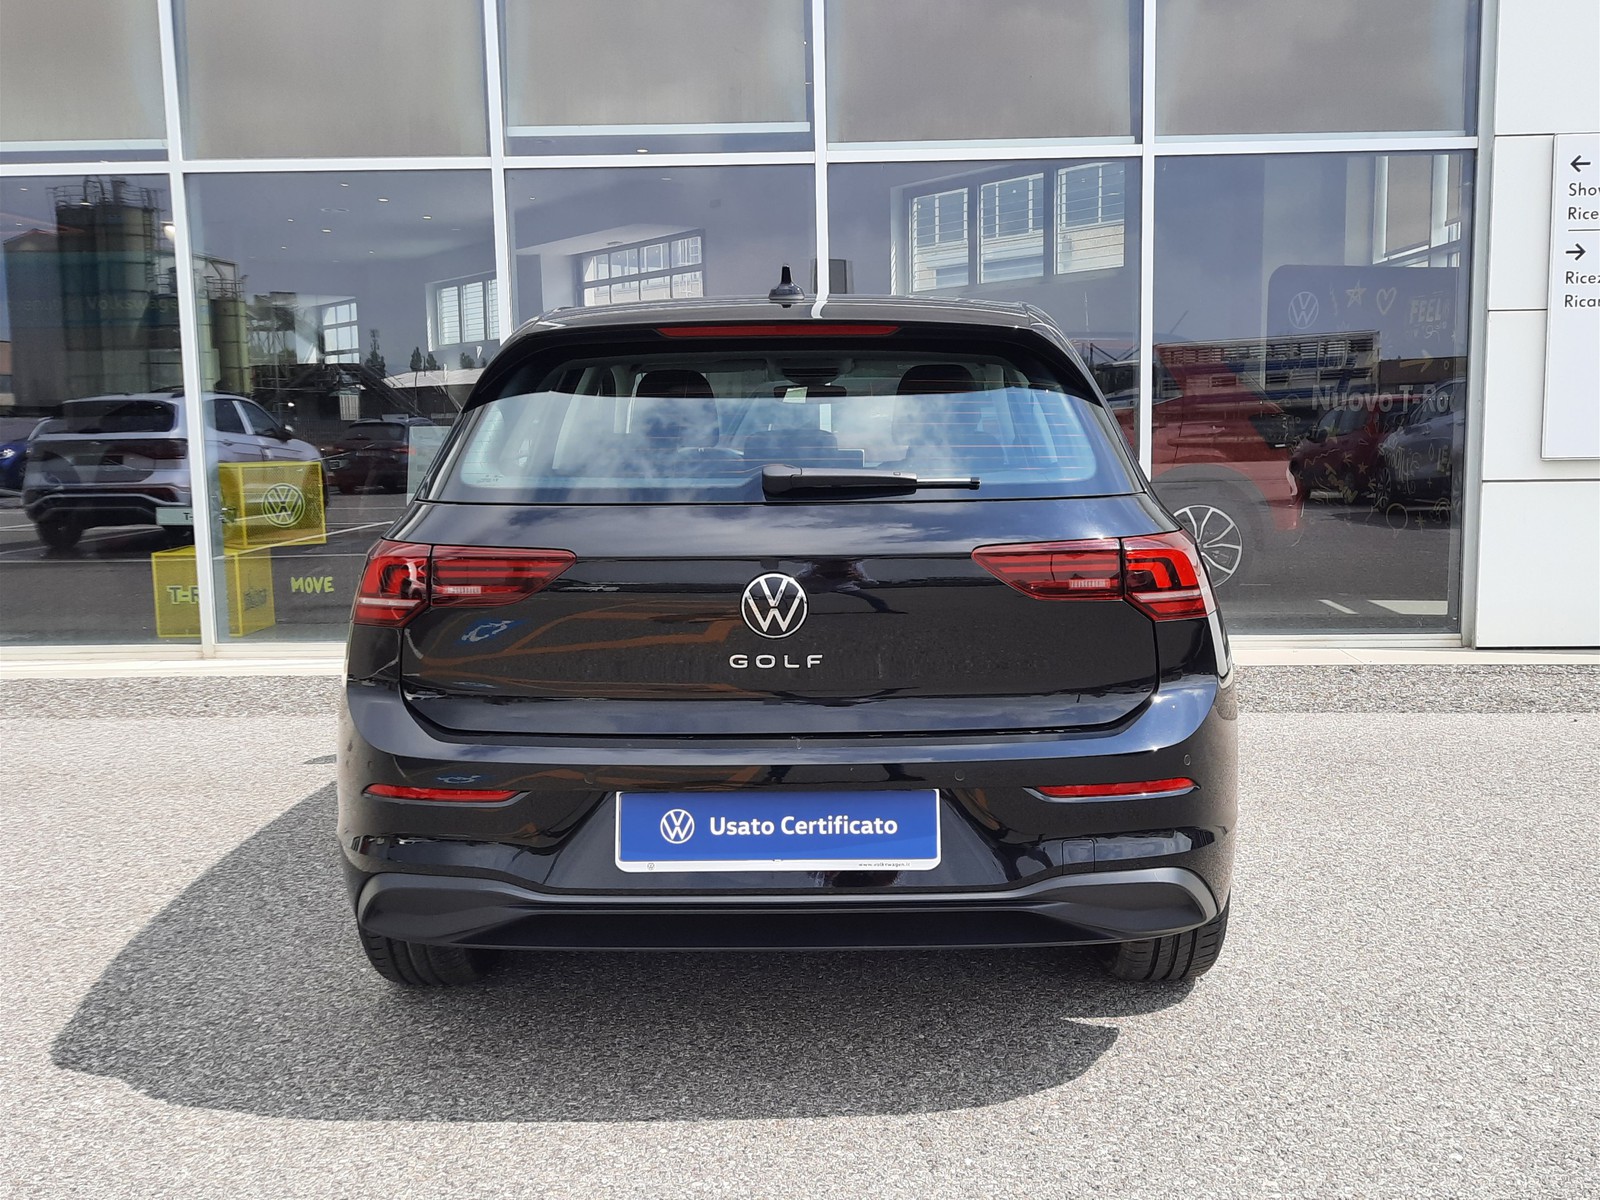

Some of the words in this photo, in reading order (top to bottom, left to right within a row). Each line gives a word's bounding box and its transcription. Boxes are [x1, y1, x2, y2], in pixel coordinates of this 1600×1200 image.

[1564, 294, 1600, 308] Rica
[1311, 384, 1393, 412] Nuovo
[290, 576, 334, 594] MOVE
[729, 654, 823, 669] GOLF
[710, 817, 775, 835] Usato
[781, 815, 898, 835] Certificato
